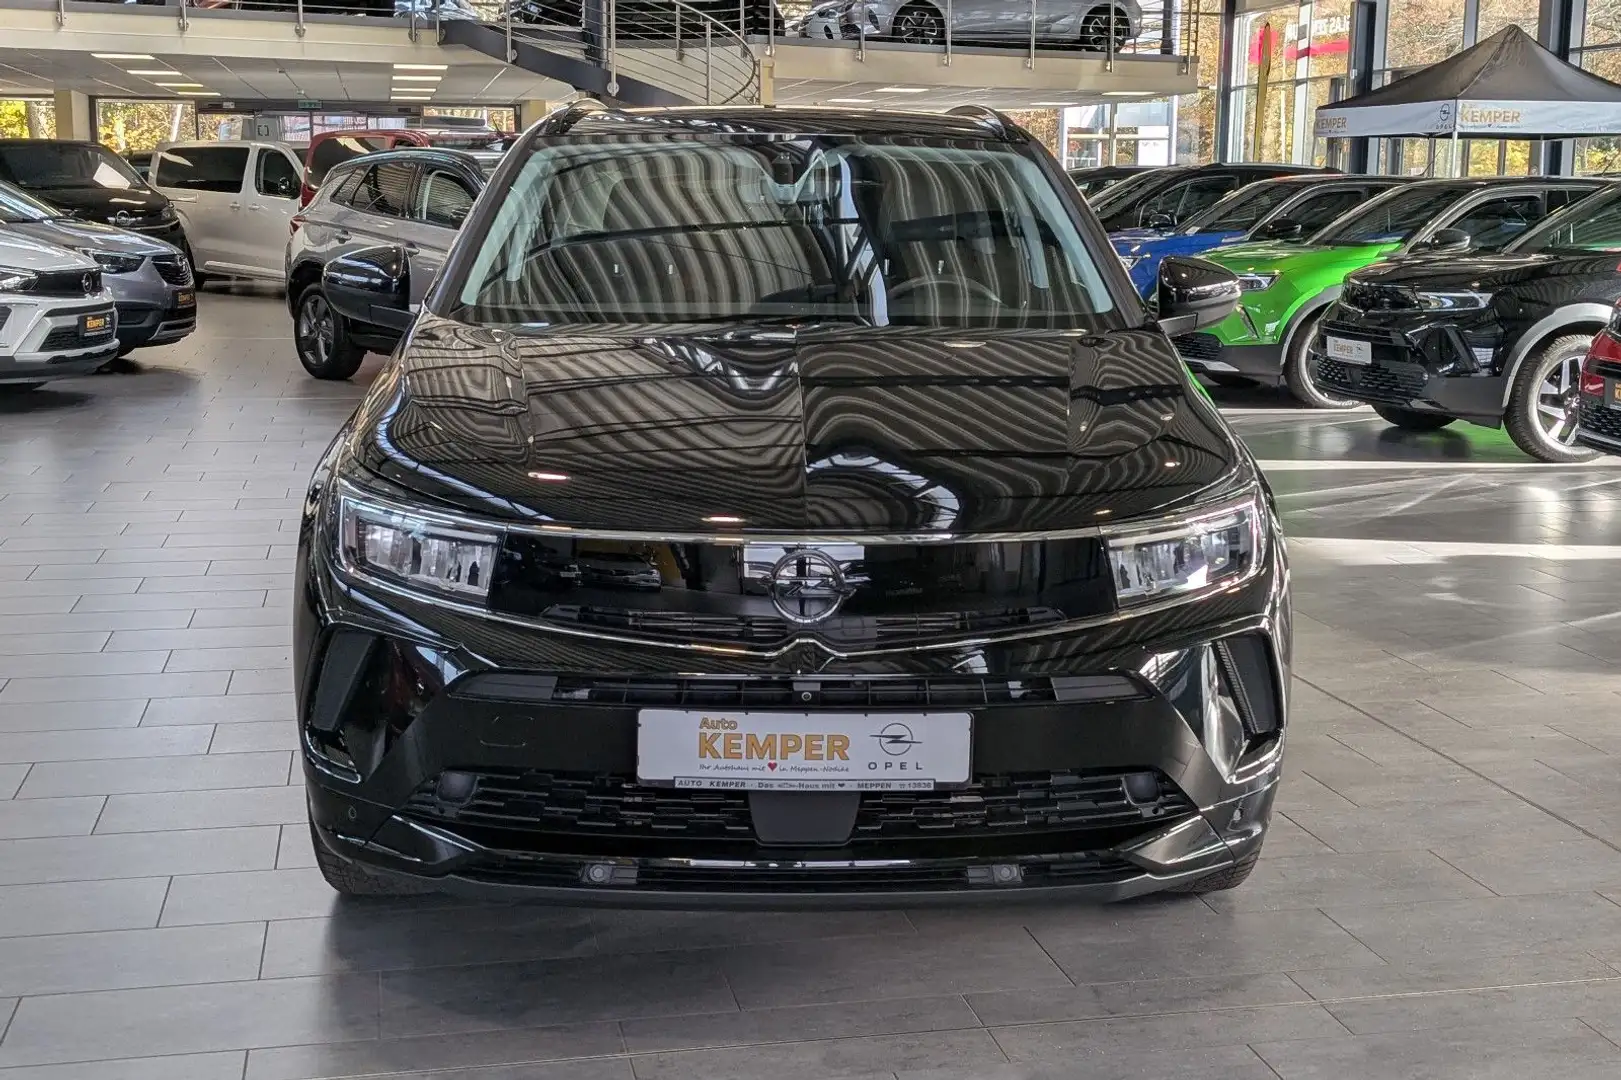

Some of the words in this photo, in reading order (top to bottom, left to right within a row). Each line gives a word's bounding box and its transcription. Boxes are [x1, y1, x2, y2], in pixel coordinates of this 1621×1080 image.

[1460, 110, 1521, 123] KEMPER
[699, 717, 738, 730] Auto
[698, 732, 850, 760] KEMPER
[867, 762, 923, 771] OPEL
[709, 780, 746, 788] KEMPER
